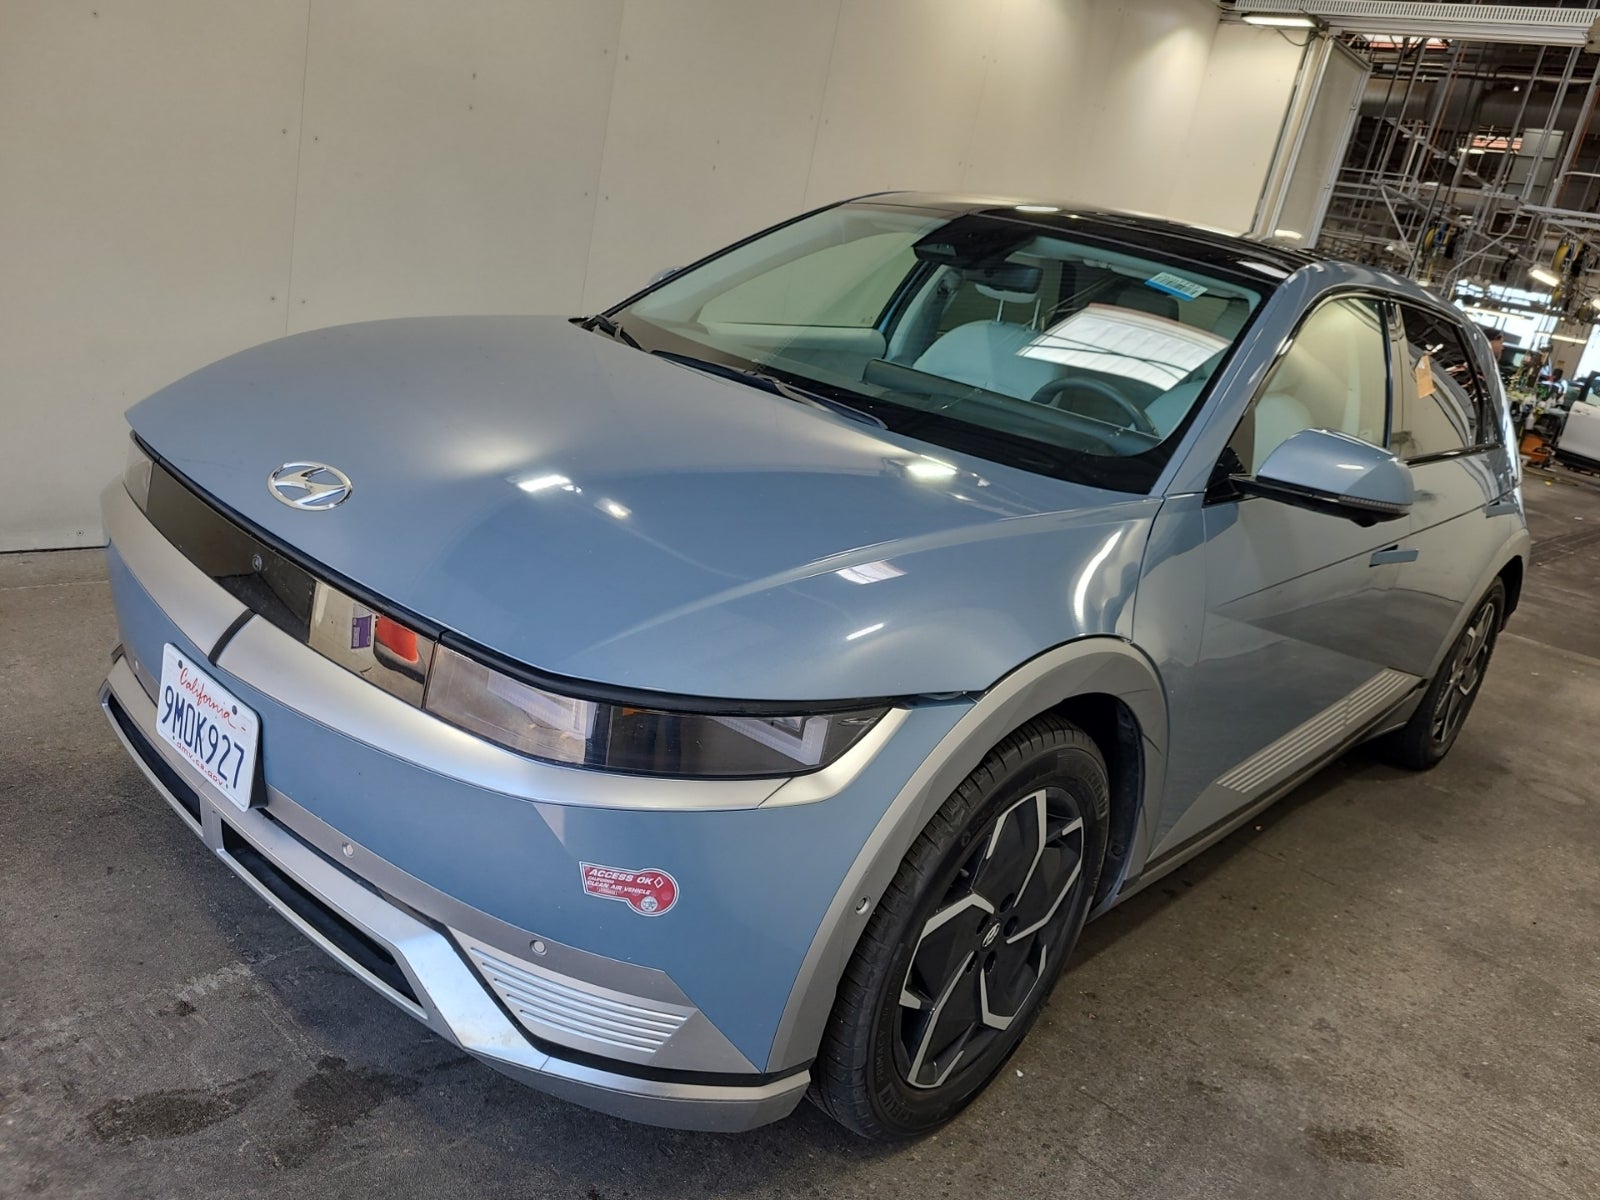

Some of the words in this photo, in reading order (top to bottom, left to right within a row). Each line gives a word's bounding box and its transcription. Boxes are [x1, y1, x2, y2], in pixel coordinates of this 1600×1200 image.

[179, 666, 236, 729] California
[162, 685, 245, 789] 9MOK927
[587, 880, 609, 888] CLEAN
[624, 885, 651, 895] VEHICLE
[589, 868, 633, 882] ACCESS
[636, 876, 654, 885] OK
